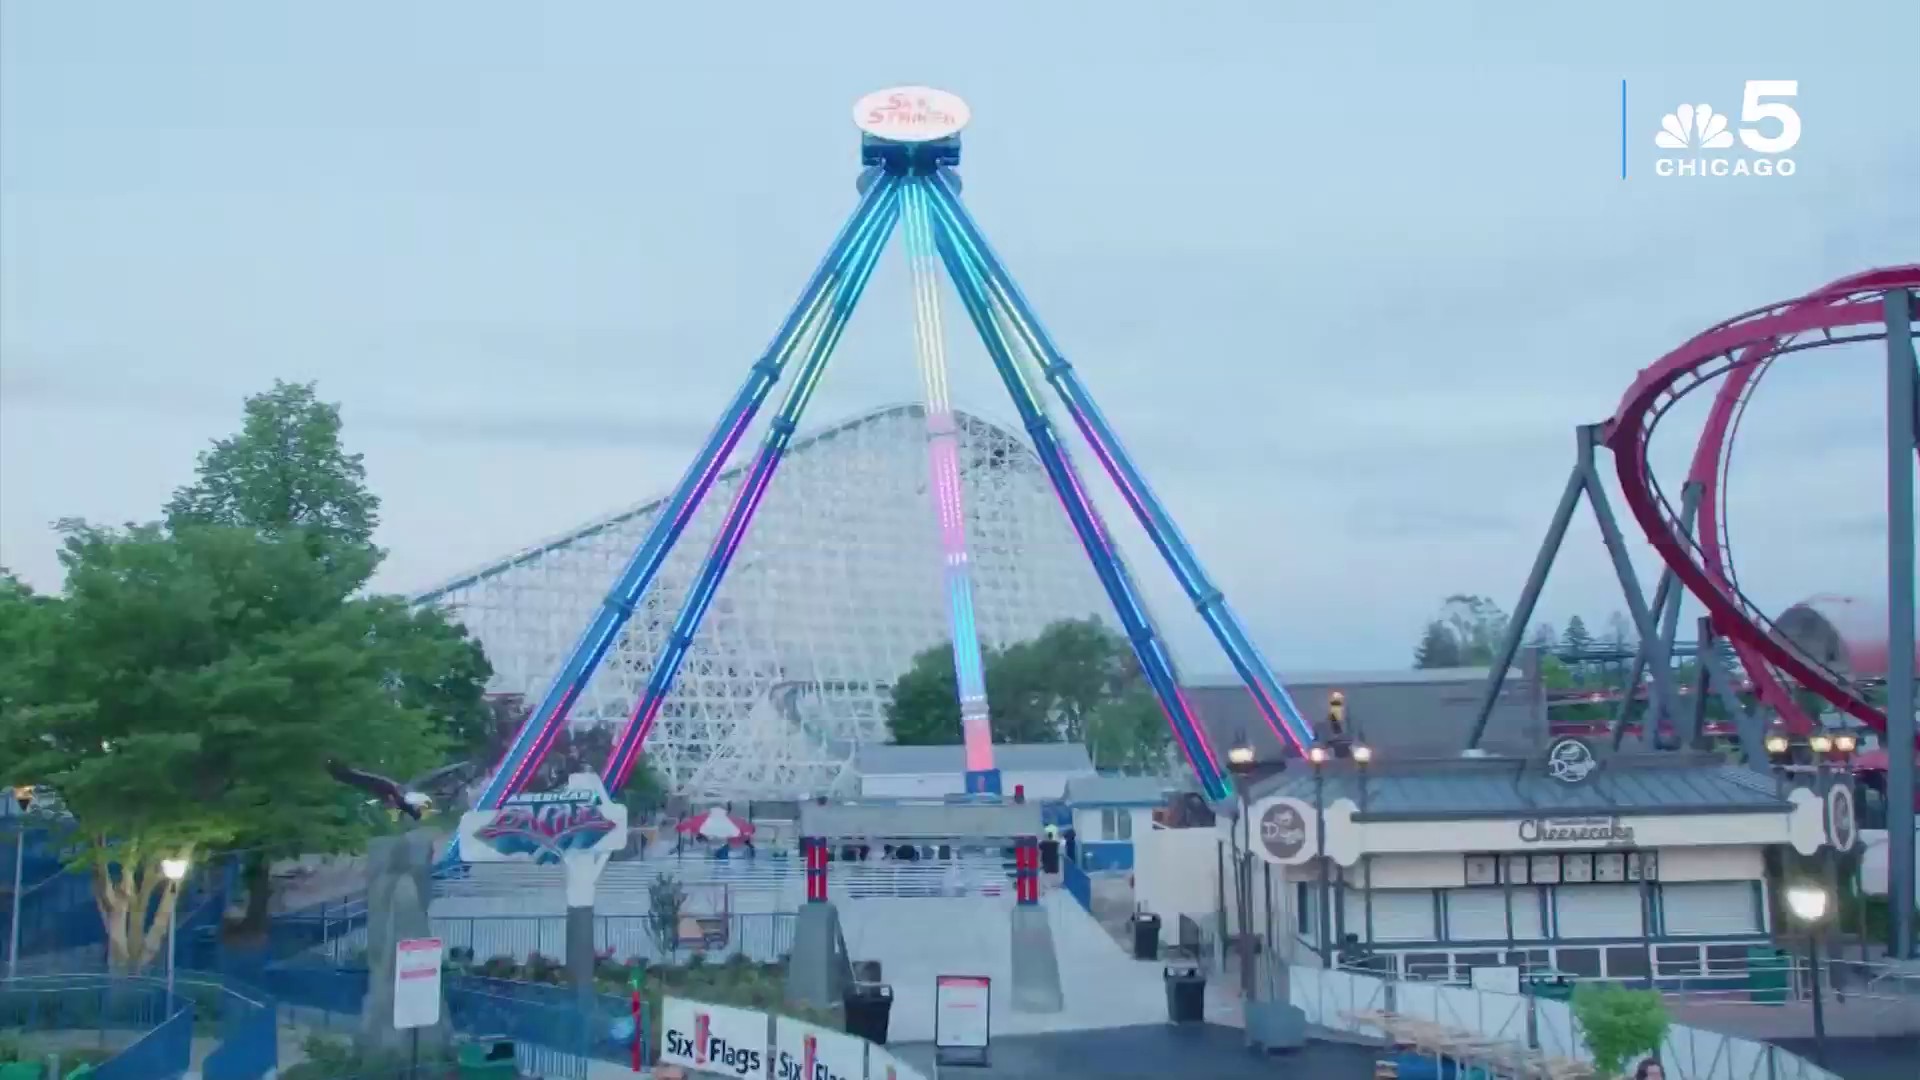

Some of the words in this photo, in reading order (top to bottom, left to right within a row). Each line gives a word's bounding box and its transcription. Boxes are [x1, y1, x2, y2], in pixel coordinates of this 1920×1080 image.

[667, 1029, 694, 1058] Six
[709, 1037, 761, 1074] Flags
[778, 1051, 802, 1080] Six
